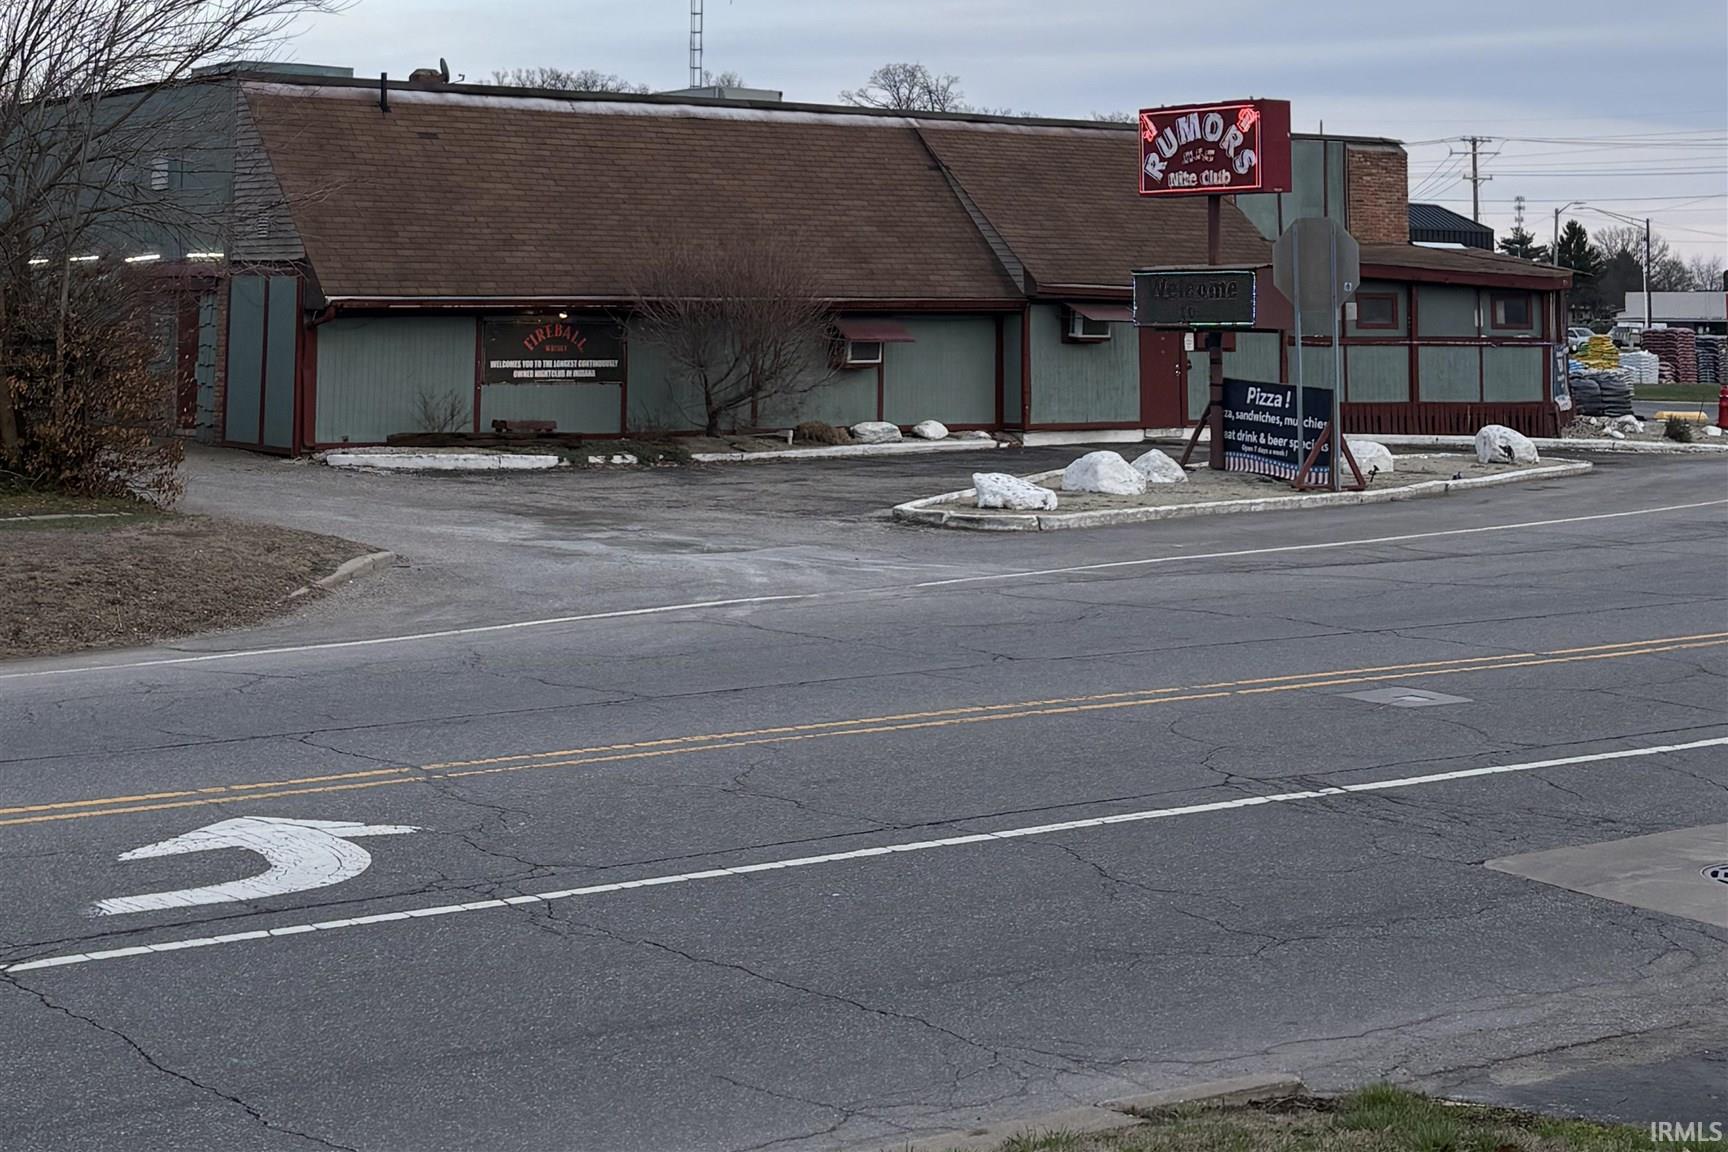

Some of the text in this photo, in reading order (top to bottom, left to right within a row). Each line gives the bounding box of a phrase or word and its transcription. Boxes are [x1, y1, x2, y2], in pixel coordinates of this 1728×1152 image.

[1144, 112, 1256, 184] RUMORS
[1168, 169, 1231, 187] Nite Club
[523, 322, 588, 352] FIREBALL
[1235, 410, 1283, 427] sandwiches,
[1236, 429, 1258, 444] drink
[1259, 432, 1266, 445] &
[1267, 433, 1288, 447] beer
